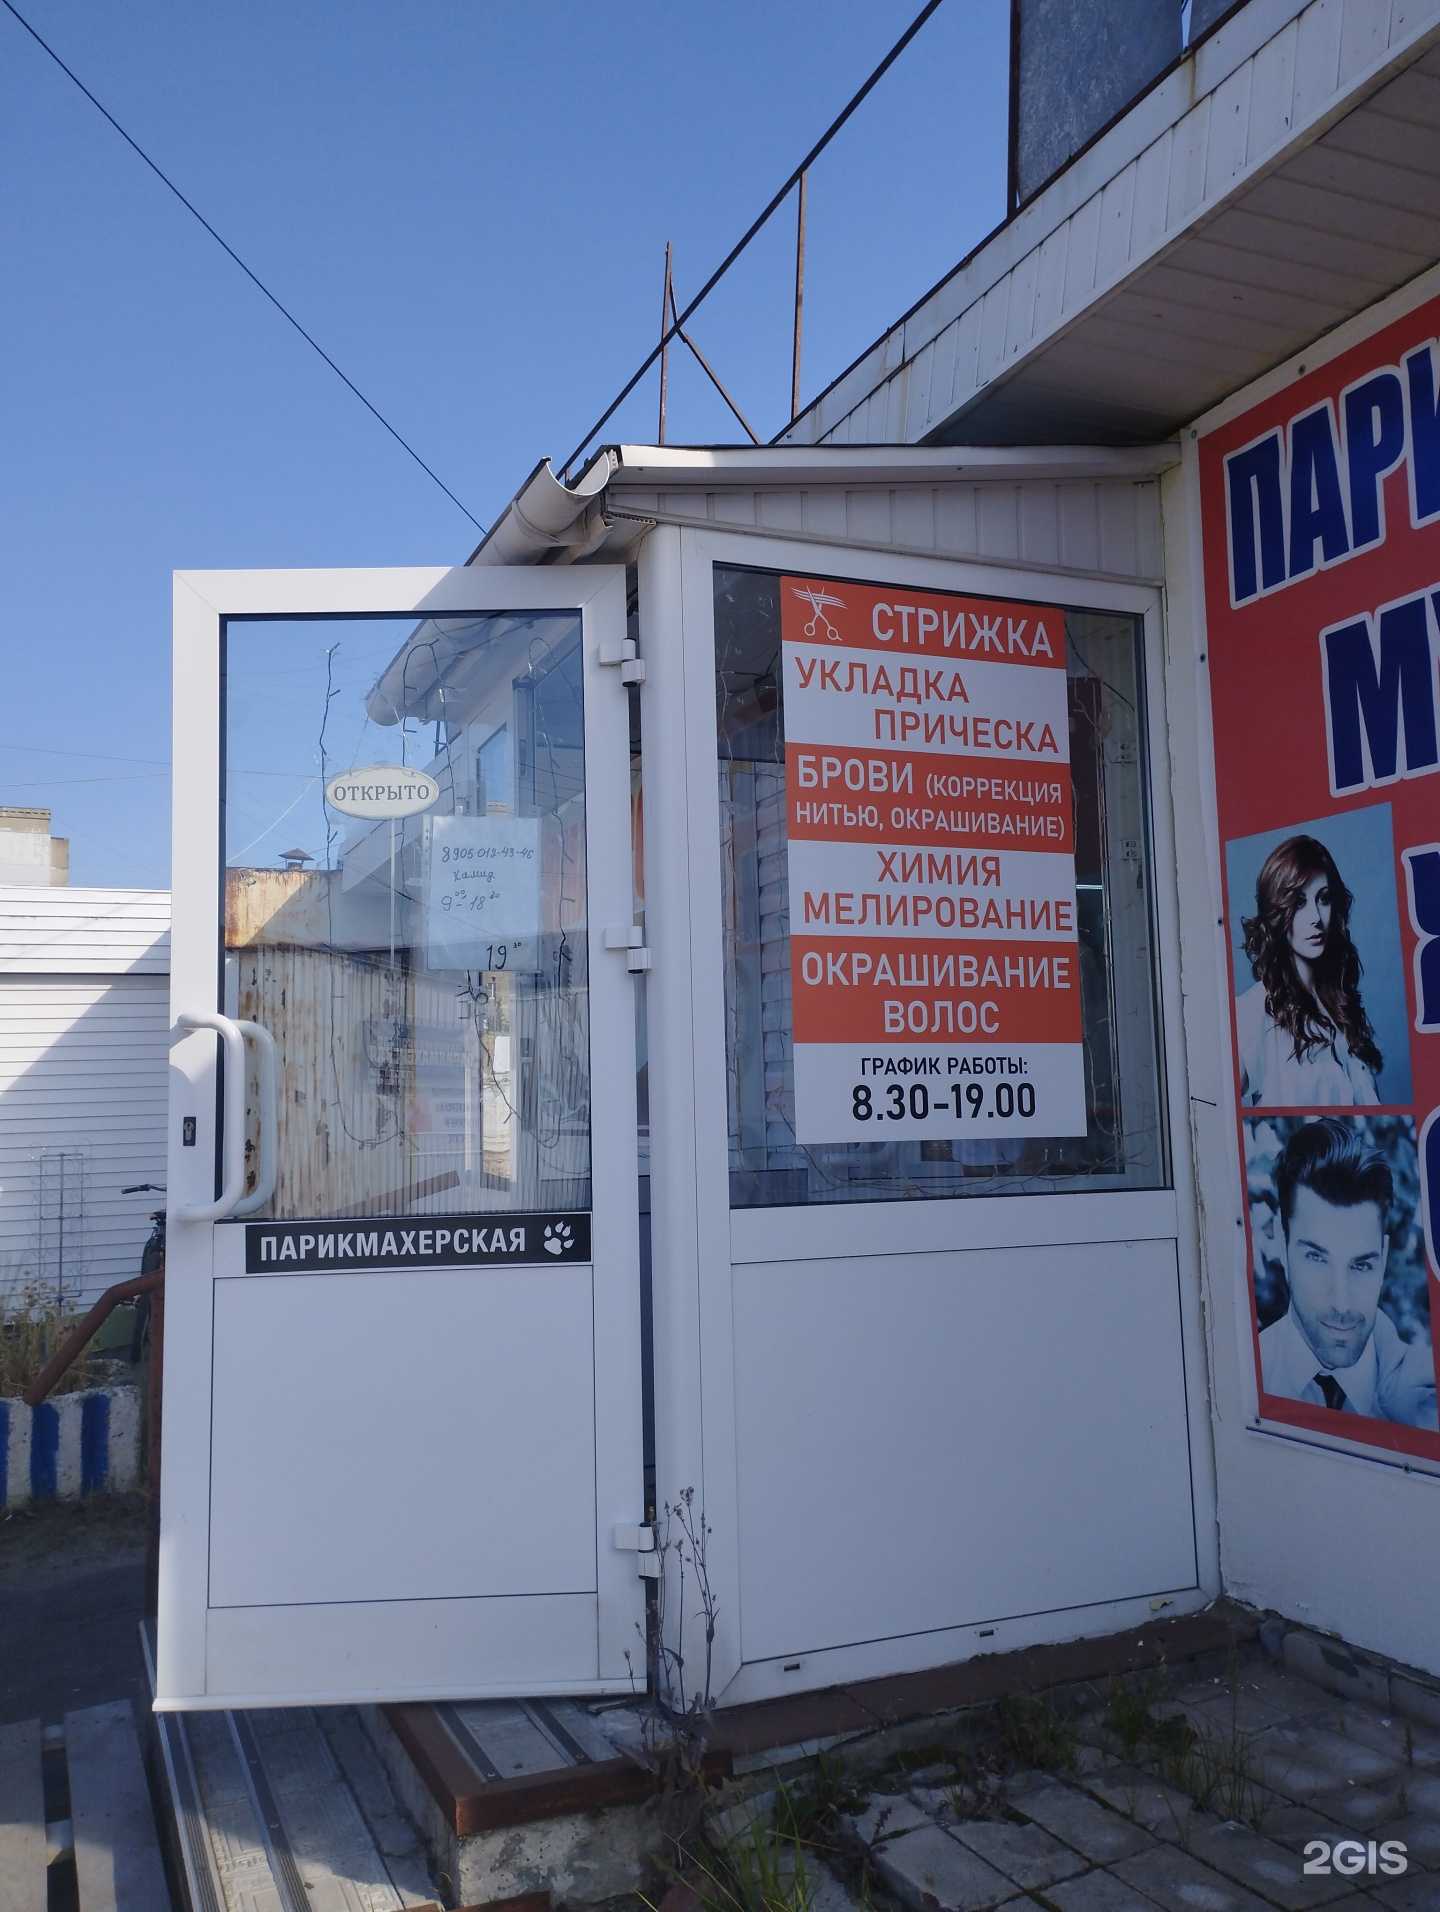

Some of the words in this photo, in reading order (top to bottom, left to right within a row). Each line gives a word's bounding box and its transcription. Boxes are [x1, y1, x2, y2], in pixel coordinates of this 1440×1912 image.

[872, 602, 1054, 658] СТРИЖКА
[795, 656, 970, 704] УКЛАДКА
[1319, 583, 1440, 798] М
[874, 708, 1059, 753] ПРИЧЕСКА
[334, 784, 430, 801] ОТКРЫТО
[797, 755, 914, 794] БРОВИ
[926, 773, 1062, 806] (КОРРЕКЦИЯ
[796, 801, 884, 831] НИТЬЮ,
[891, 807, 1065, 840] ОКРАШИВАНИЕ)
[877, 851, 1001, 887] ХИМИЯ
[803, 891, 1073, 931] МЕЛИРОВАНИЕ
[801, 951, 1071, 989] ОКРАШИВАНИЕ
[884, 1000, 1000, 1033] ВОЛОС
[861, 1057, 941, 1076] ГРАФИК
[947, 1056, 1028, 1075] РАБОТЫ:
[852, 1082, 1036, 1121] 8.30-19.00
[260, 1227, 526, 1261] ПАРИКМАХЕРСКАЯ
